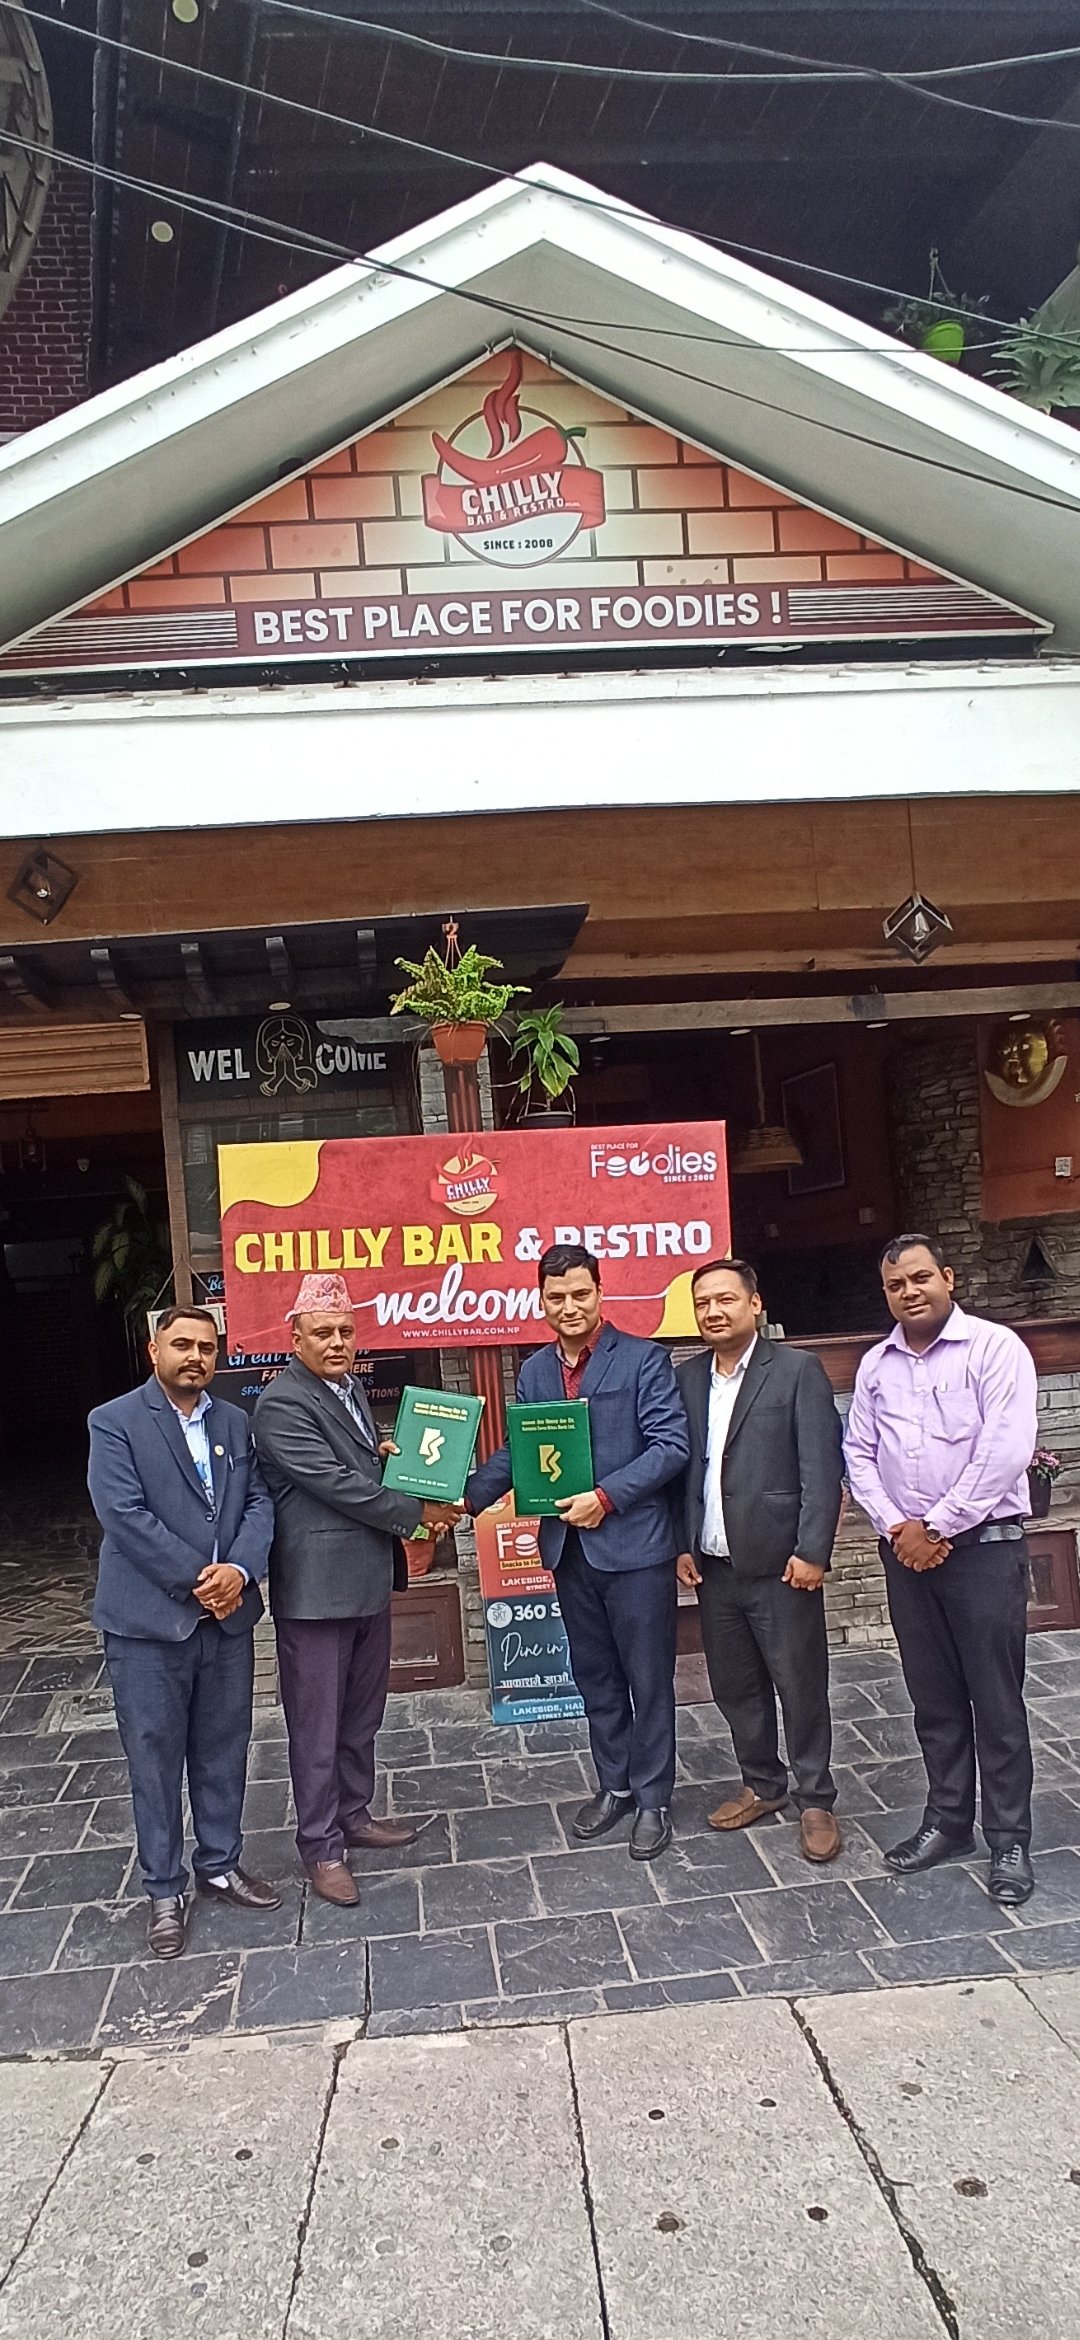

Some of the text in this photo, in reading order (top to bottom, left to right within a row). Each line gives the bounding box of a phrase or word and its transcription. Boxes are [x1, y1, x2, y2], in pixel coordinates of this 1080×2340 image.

[462, 471, 562, 515] CHILLY
[467, 513, 494, 526] BAR
[500, 510, 507, 520] &
[513, 497, 564, 518] RESTRO
[484, 540, 515, 550] SINCE
[524, 538, 553, 549] 2008
[253, 606, 353, 645] BEST
[363, 601, 493, 639] PLACE
[501, 598, 581, 633] FOR
[590, 593, 760, 629] FOODIES
[187, 1048, 251, 1082] WEL
[446, 1176, 490, 1196] CHILLY
[663, 1175, 686, 1183] SINCE
[234, 1226, 393, 1274] CHILLY
[401, 1222, 503, 1267] BAR
[514, 1227, 543, 1261] &
[374, 1262, 547, 1326] welcom
[402, 1326, 520, 1338] WWW.CHILLYBAR.COM.NP
[351, 1362, 375, 1374] ERE
[241, 1385, 265, 1397] SPAC
[501, 1575, 552, 1587] LAKESIDE,
[513, 1603, 547, 1621] 360
[500, 1631, 543, 1672] Dine
[547, 1643, 564, 1655] in
[512, 1704, 563, 1716] LAKESIDE,
[537, 1712, 562, 1720] STREET
